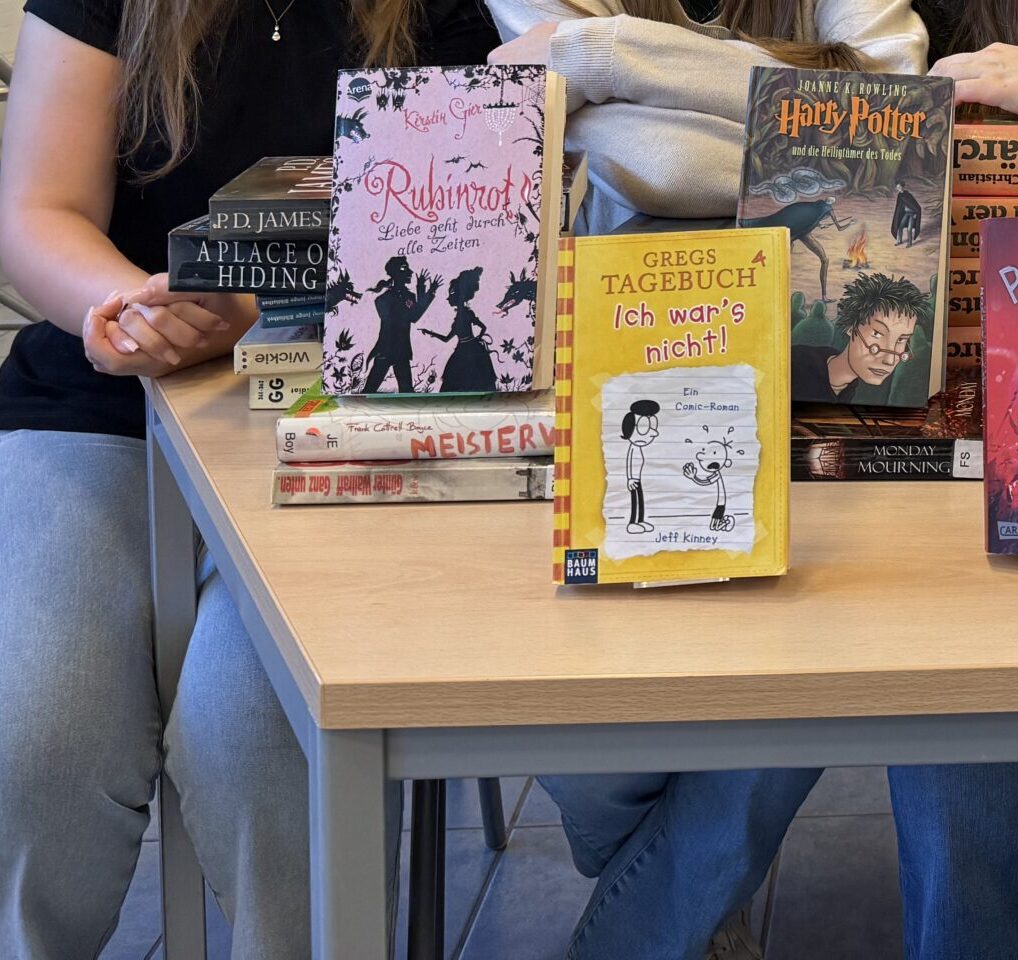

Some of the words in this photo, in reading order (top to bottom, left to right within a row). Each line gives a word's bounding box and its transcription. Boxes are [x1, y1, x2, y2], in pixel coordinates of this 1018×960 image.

[348, 84, 372, 94] Arena
[798, 80, 839, 94] JOANNE
[844, 82, 854, 94] K.
[859, 84, 908, 96] ROWLING
[402, 106, 447, 132] Kerstin
[449, 98, 482, 140] Gier
[774, 98, 848, 138] Harry
[848, 96, 927, 144] Potter
[792, 145, 806, 156] und
[808, 146, 820, 157] die
[821, 146, 864, 160] Heiligtümer
[866, 150, 878, 160] des
[880, 150, 902, 161] Todes
[364, 154, 514, 223] Rubinrot
[256, 211, 322, 234] JAMES
[378, 221, 420, 240] Liebe
[428, 220, 457, 240] geht
[466, 214, 505, 230] durch
[197, 241, 210, 262] A
[218, 242, 298, 264] PLACE
[398, 238, 423, 256] alle
[430, 238, 480, 254] Zeiten
[643, 248, 716, 268] GREGS
[218, 266, 317, 290] HIDING
[601, 268, 757, 294] TAGEBUCH
[614, 302, 654, 329] Ich
[668, 298, 746, 326] war's
[646, 326, 728, 364] nicht!
[254, 351, 310, 364] Wickie
[268, 378, 284, 404] GG
[683, 388, 698, 397] Ein
[675, 402, 740, 412] Comic-Roman
[346, 422, 370, 432] Frank
[373, 422, 402, 433] Cottrell
[406, 422, 433, 433] Boyce
[284, 432, 296, 454] Boy
[326, 434, 338, 448] JE
[874, 446, 936, 456] MONDAY
[960, 451, 970, 468] FS
[858, 460, 950, 474] MOURNING
[278, 476, 306, 494] unten.
[309, 476, 330, 496] Ganz
[336, 476, 372, 497] Wallraff
[373, 475, 402, 497] Günter
[655, 532, 678, 544] Jeff
[683, 533, 718, 545] Kinney
[566, 560, 596, 568] BAUM
[566, 568, 596, 577] HAUS
